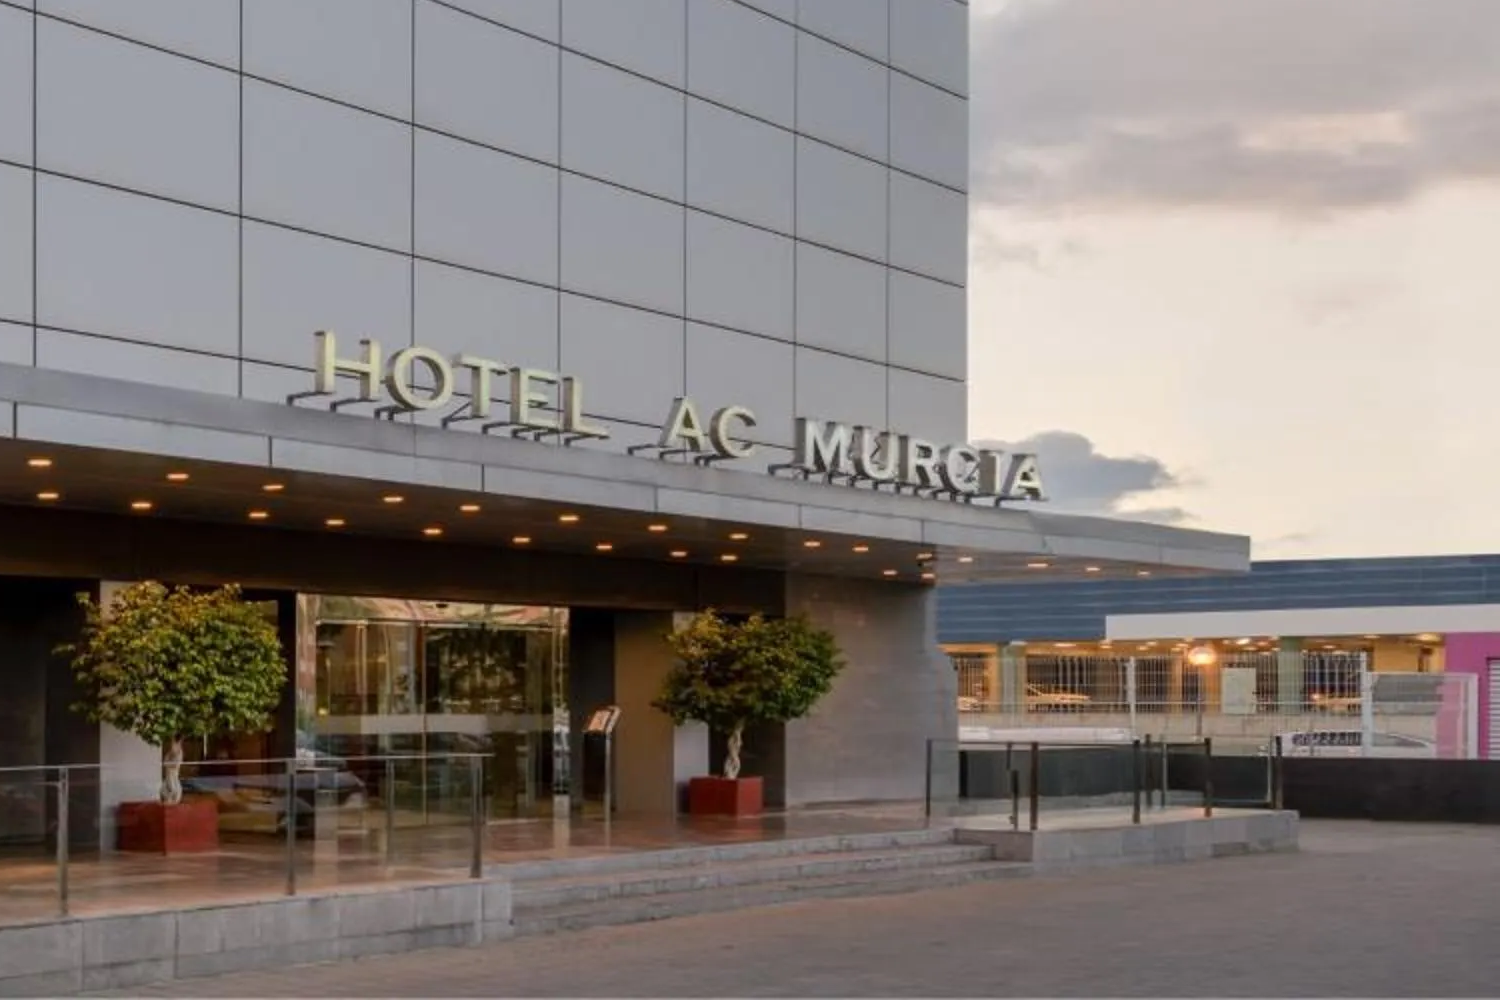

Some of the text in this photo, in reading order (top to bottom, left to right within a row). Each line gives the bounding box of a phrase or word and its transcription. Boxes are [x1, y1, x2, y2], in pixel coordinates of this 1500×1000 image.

[313, 329, 1047, 500] HOTEL AC MURCIA
